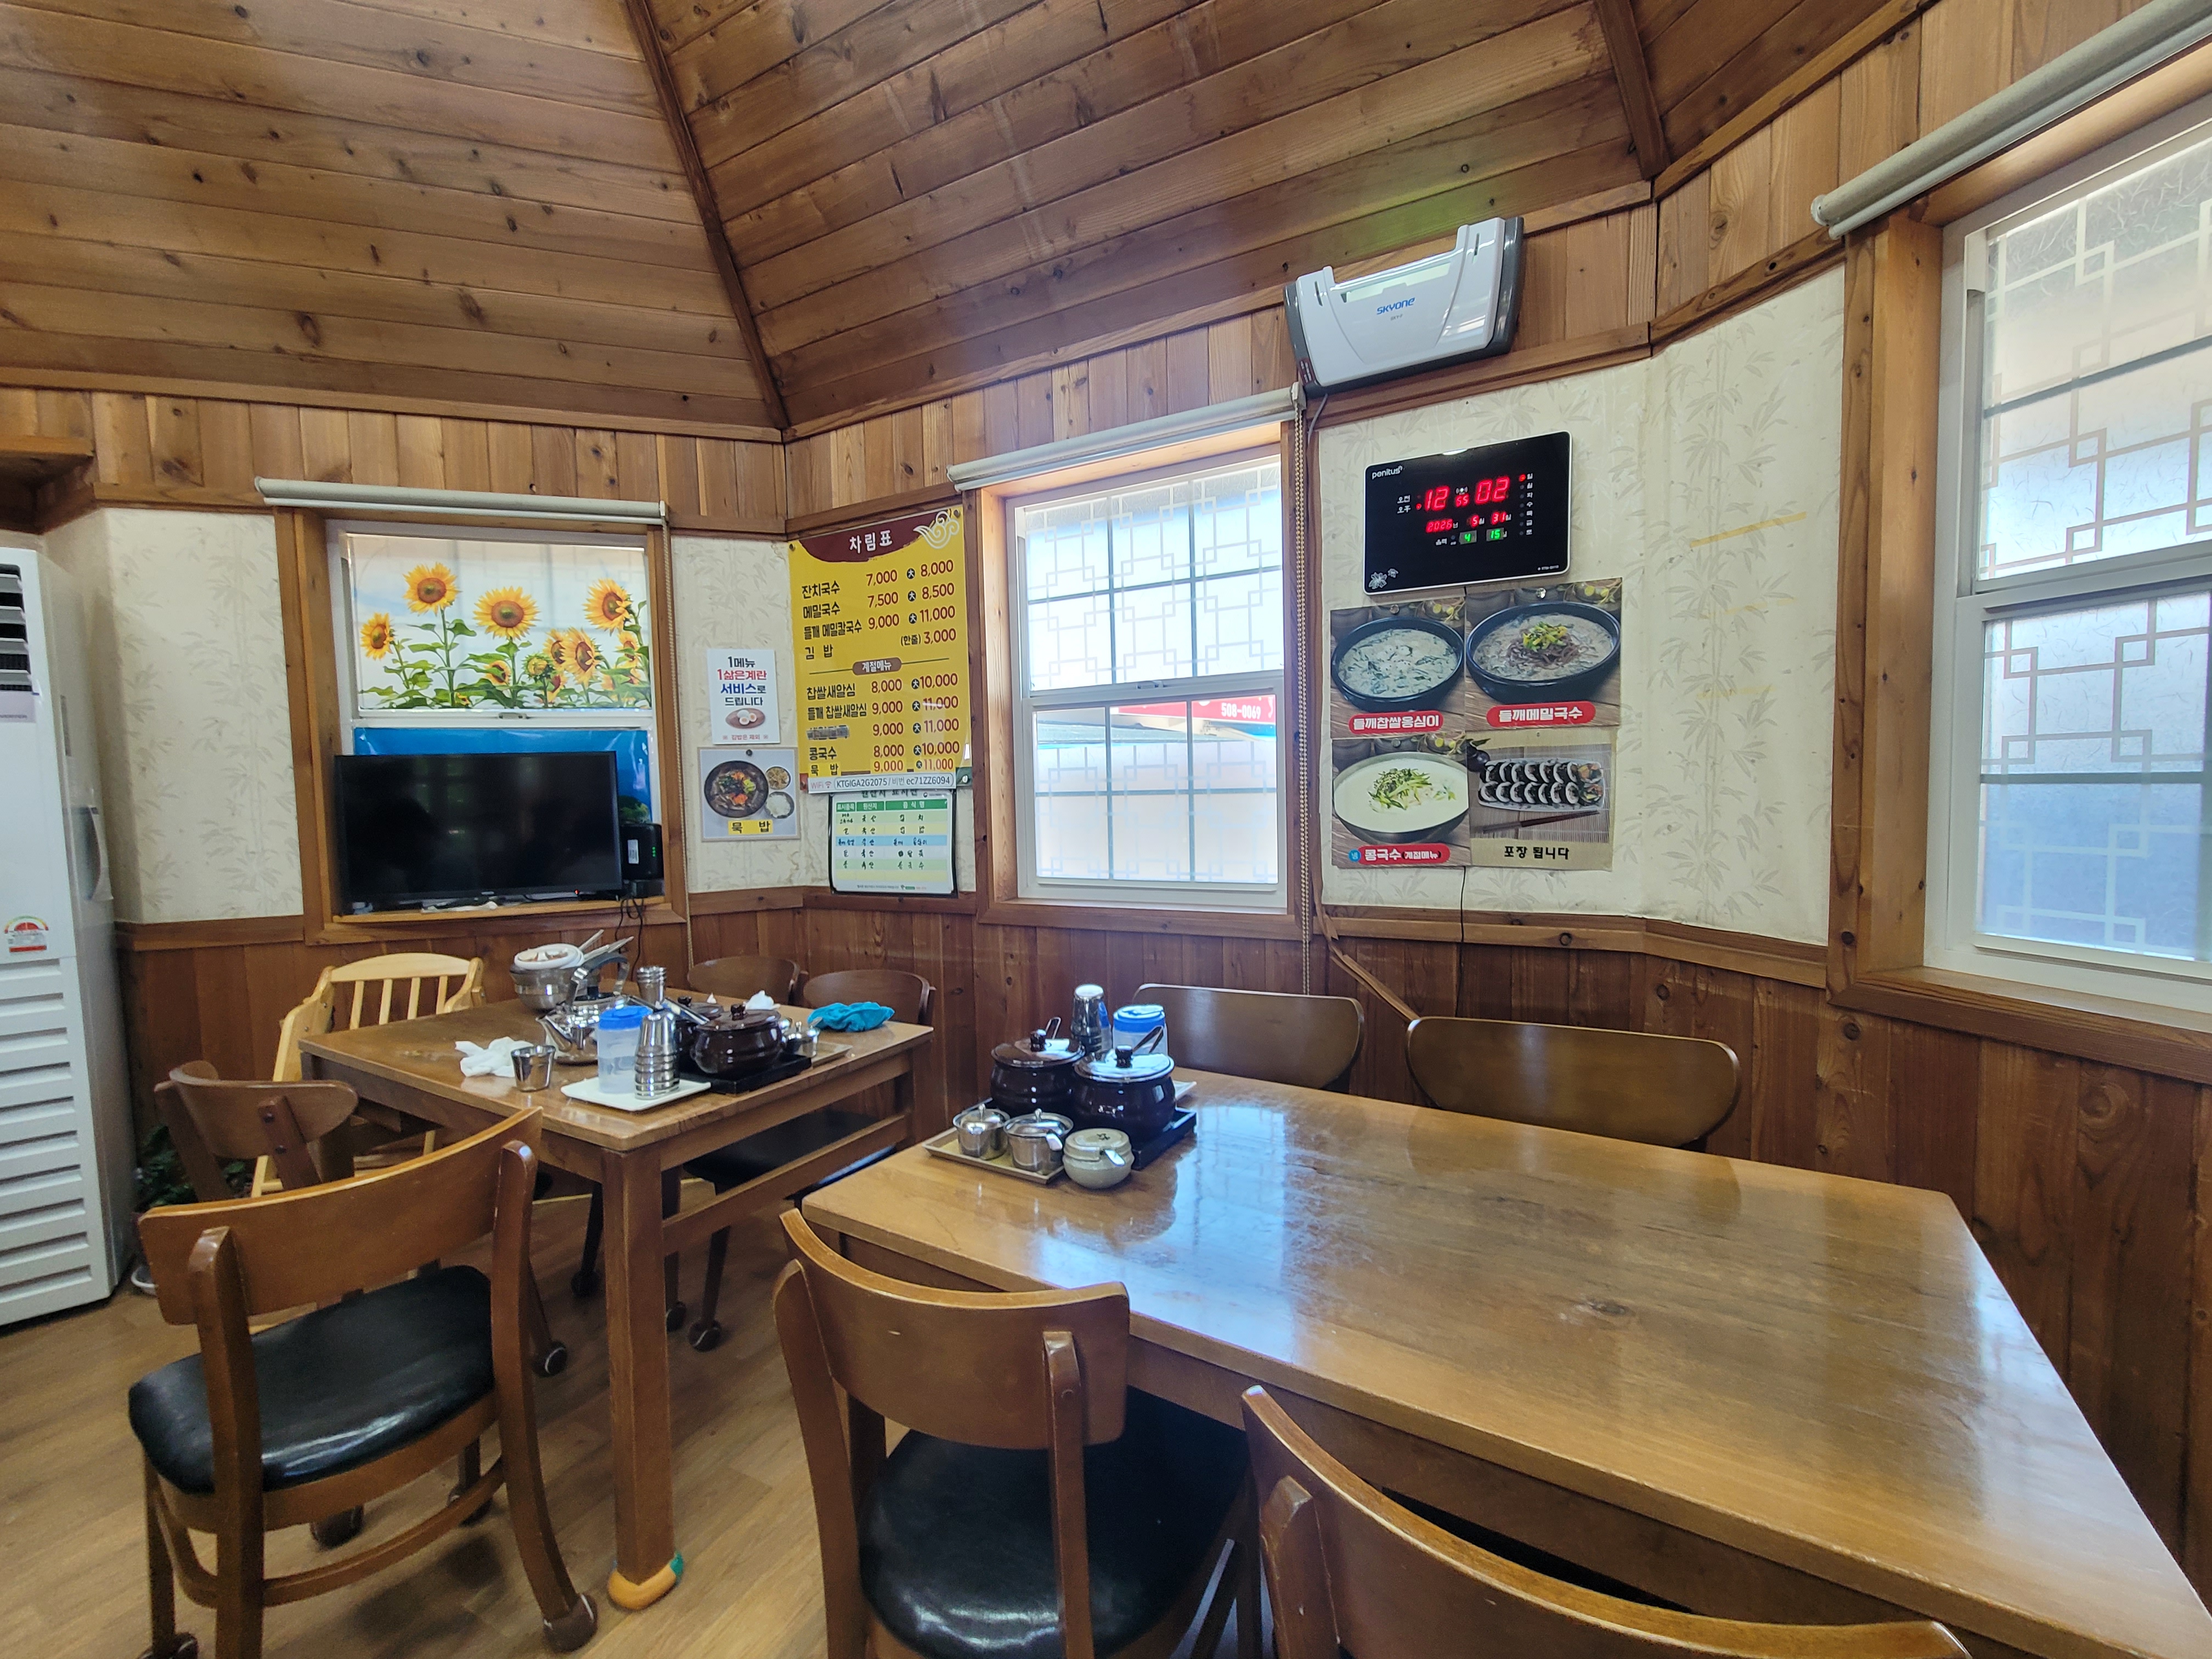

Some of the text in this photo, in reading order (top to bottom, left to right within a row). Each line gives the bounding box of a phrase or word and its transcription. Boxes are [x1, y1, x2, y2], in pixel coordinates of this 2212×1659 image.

[1372, 468, 1401, 479] penitus
[1425, 486, 1449, 511] 12
[1476, 476, 1510, 504] 02
[1426, 519, 1453, 533] 2026
[849, 530, 893, 554] 차림표
[1464, 533, 1471, 541] 4
[1491, 529, 1500, 539] 15
[802, 580, 840, 599] 잔치국수
[866, 569, 898, 586] 7,000
[920, 559, 953, 577] 8,000
[803, 601, 840, 619] 메밀국수
[867, 591, 899, 608] 7,500
[922, 583, 955, 600] 8,500
[804, 625, 820, 640] 들깨
[822, 619, 862, 635] 메밀칼국수
[868, 614, 900, 630] 9,000
[920, 606, 956, 623] 11,000
[923, 628, 956, 645] 3,000
[727, 656, 755, 668] 1메뉴
[862, 660, 892, 673] 계절메뉴
[717, 669, 767, 680] 1삶은계란
[720, 683, 766, 694] 서비스로
[807, 683, 855, 700] 찹쌀새알심
[871, 679, 902, 693] 8,000
[919, 673, 958, 689] 10,000
[725, 697, 763, 706] 드립니다
[808, 707, 823, 720] 들깨
[826, 703, 867, 719] 찹쌀새알심
[872, 701, 903, 715] 9,000
[923, 696, 958, 710] 11,000
[1221, 702, 1261, 720] 508-0069
[1499, 707, 1583, 723] 들깨메밀국수
[872, 723, 904, 737] 9,000
[924, 718, 959, 733] 11,000
[1353, 715, 1439, 730] 들깨찹쌀옹심이
[809, 746, 837, 760] 콩국수
[873, 744, 904, 758] 8,000
[922, 741, 960, 755] 10,000
[873, 760, 904, 773] 9,000
[924, 758, 953, 770] 11,000
[891, 776, 905, 785] 비번
[1365, 849, 1401, 861] 콩국수
[1504, 846, 1569, 860] 포장 됩니다
